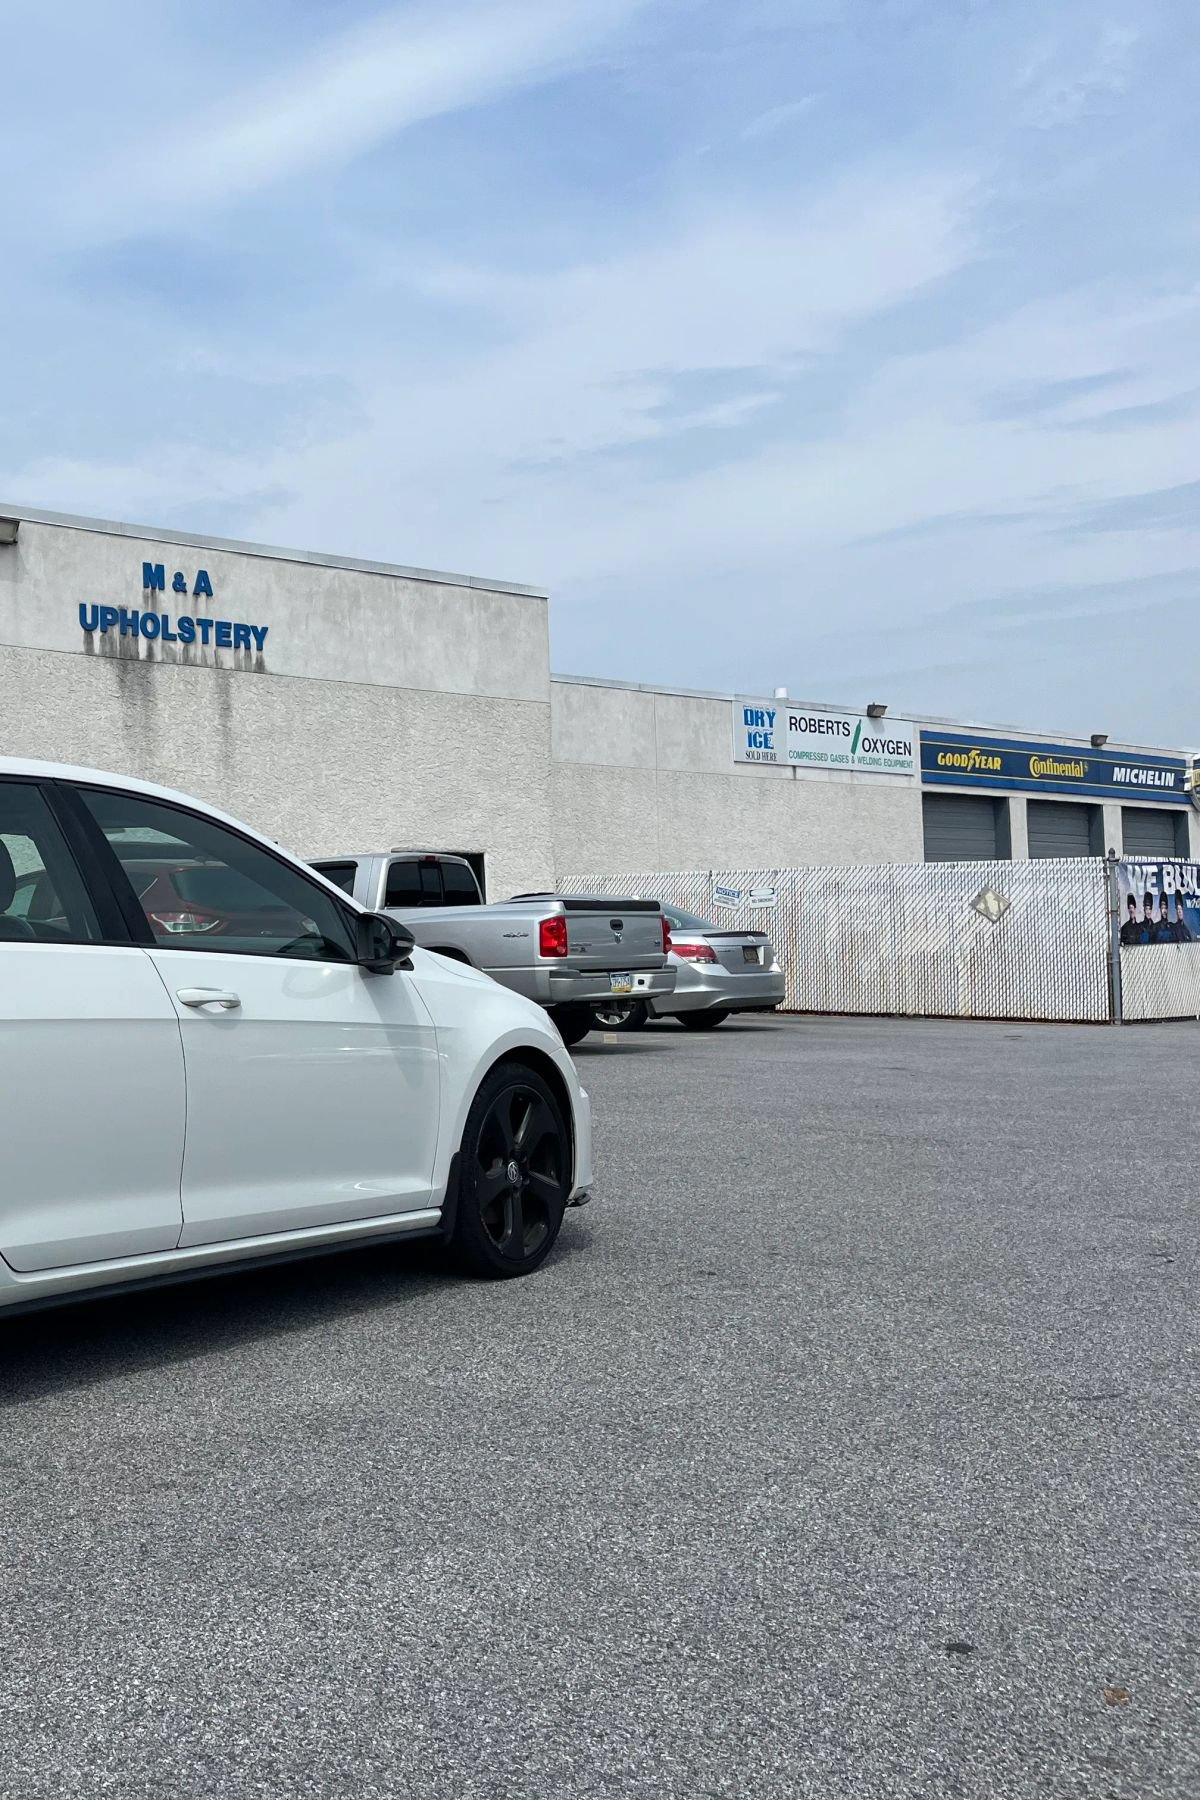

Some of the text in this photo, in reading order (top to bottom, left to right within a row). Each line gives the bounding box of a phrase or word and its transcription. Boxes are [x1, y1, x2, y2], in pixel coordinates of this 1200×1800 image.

[142, 562, 213, 597] M & A
[79, 603, 269, 651] UPHOLSTERY
[743, 707, 776, 728] DRY
[789, 716, 851, 737] ROBERTS
[747, 731, 774, 750] ICE
[862, 737, 912, 756] OXYGEN
[745, 750, 777, 762] SOLD HERE
[789, 750, 828, 762] COMPRESSED
[830, 754, 850, 764] GASES
[857, 756, 882, 767] WELDING
[884, 758, 914, 769] EQUIPMENT
[937, 750, 1001, 771] GOODYEAR
[1029, 756, 1084, 778] Continental
[1113, 766, 1175, 787] MICHELIN
[1127, 864, 1158, 895] WE
